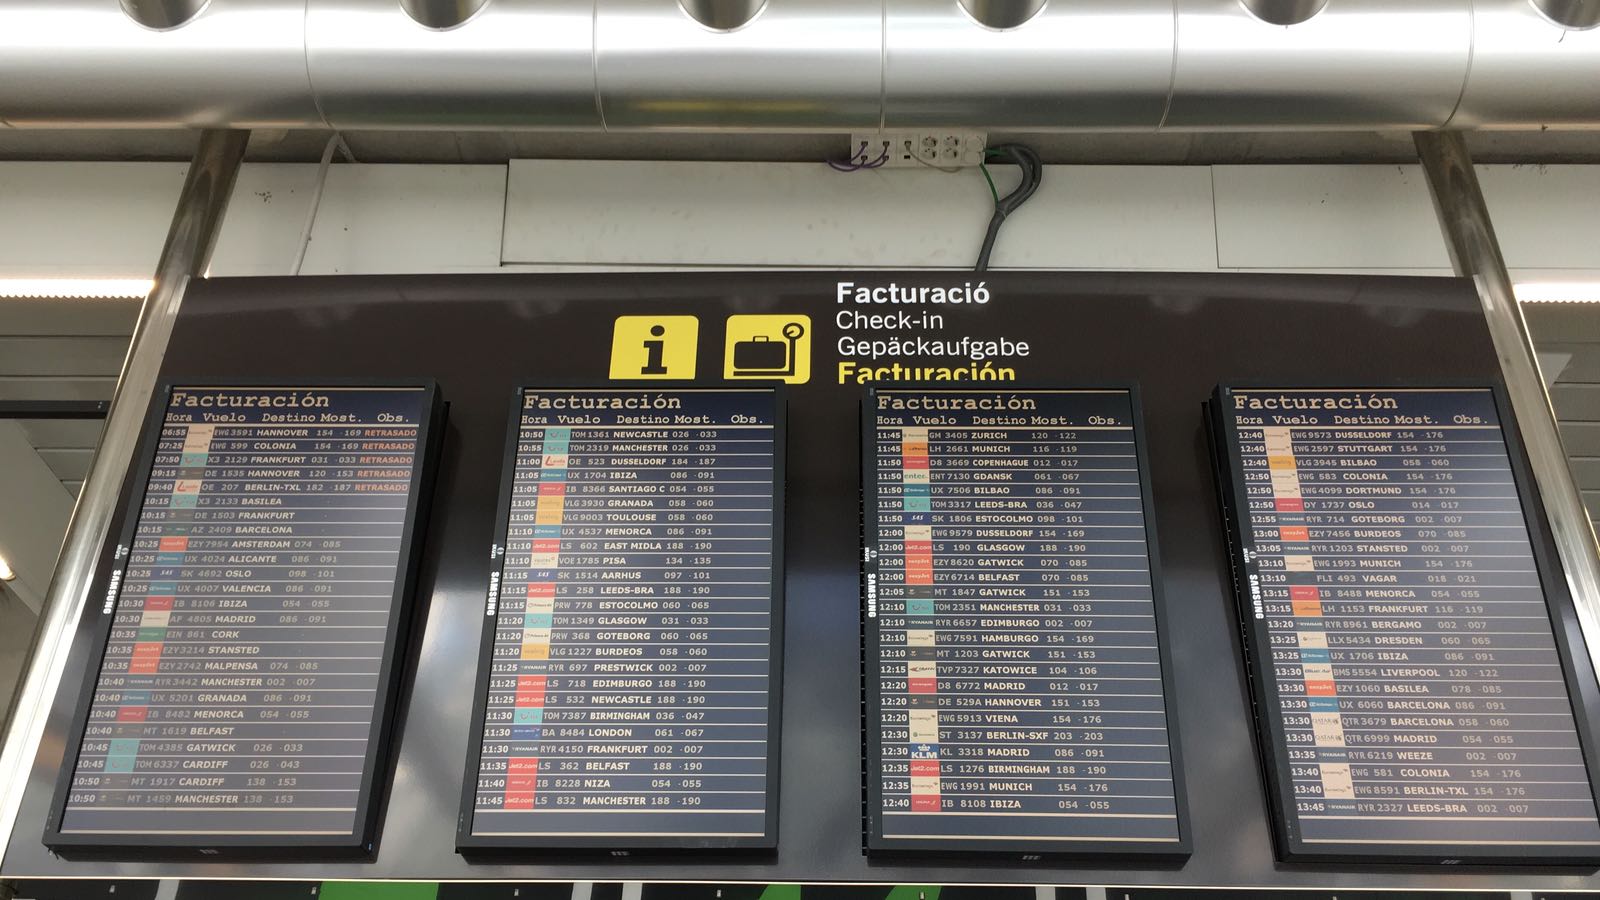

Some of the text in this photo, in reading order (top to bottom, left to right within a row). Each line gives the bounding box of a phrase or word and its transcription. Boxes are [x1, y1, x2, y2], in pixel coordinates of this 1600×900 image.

[836, 281, 990, 304] Facturació
[836, 311, 944, 332] Check-in
[837, 336, 1030, 360] Gepäckaufgabe
[838, 361, 1016, 384] Facturación
[170, 392, 329, 408] Facturación
[523, 394, 681, 409] Facturación
[877, 395, 1036, 410] Facturación
[1234, 394, 1398, 409] Facturación
[166, 412, 409, 422] Hora Vuelo Destino Most. Obs.
[521, 414, 763, 424] Hora Vuelo Destino Most. Obs.
[876, 416, 1121, 425] Hora Vuelo Destino Most. Obs.
[1235, 415, 1488, 424] Hora Vuelo Destino Most. Obs.
[103, 570, 121, 614] SAMSUNG
[487, 572, 499, 616] SAMSUNG
[868, 573, 876, 617] SAMSUNG
[1250, 574, 1264, 619] SAMSUNG
[980, 604, 1040, 612] MANCHESTER
[211, 630, 240, 638] CORK
[981, 634, 1039, 642] HAMBURGO
[1374, 636, 1423, 644] DRESDEN
[595, 648, 643, 656] BURDEOS
[594, 664, 653, 672] PRESTWICK
[983, 666, 1038, 674] KATOWICE
[1380, 668, 1441, 677] LIVERPOOL
[592, 680, 653, 688] EDIMBURGO
[1384, 685, 1430, 693] BASILEA
[197, 694, 247, 702] GRANADA
[591, 696, 652, 704] NEWCASTLE
[984, 698, 1042, 706] HANNOVER
[1386, 701, 1451, 710] BARCELONA
[193, 710, 244, 718] MENORCA
[590, 712, 650, 720] BIRMINGHAM
[985, 714, 1018, 723] VIENA
[1390, 718, 1454, 726] BARCELONA
[190, 727, 235, 735] BELFAST
[588, 728, 632, 737] LONDON
[986, 731, 1049, 740] BERLIN-SXF
[1393, 735, 1438, 743] MADRID
[186, 744, 236, 752] GATWICK
[587, 745, 648, 754] FRANKFURT
[987, 748, 1030, 756] MADRID
[1396, 752, 1433, 760] WEEZE
[182, 760, 228, 769] CARDIFF
[586, 762, 630, 770] BELFAST
[988, 765, 1050, 774] BIRMINGHAM
[1400, 768, 1450, 777] COLONIA
[178, 778, 225, 786] CARDIFF
[584, 779, 611, 788] NIZA
[989, 782, 1033, 791] MUNICH
[1403, 786, 1469, 795] BERLIN-TXL
[174, 795, 239, 803] MANCHESTER
[582, 796, 646, 805] MANCHESTER
[990, 800, 1022, 808] IBIZA
[1407, 804, 1468, 813] LEEDS-BRA
